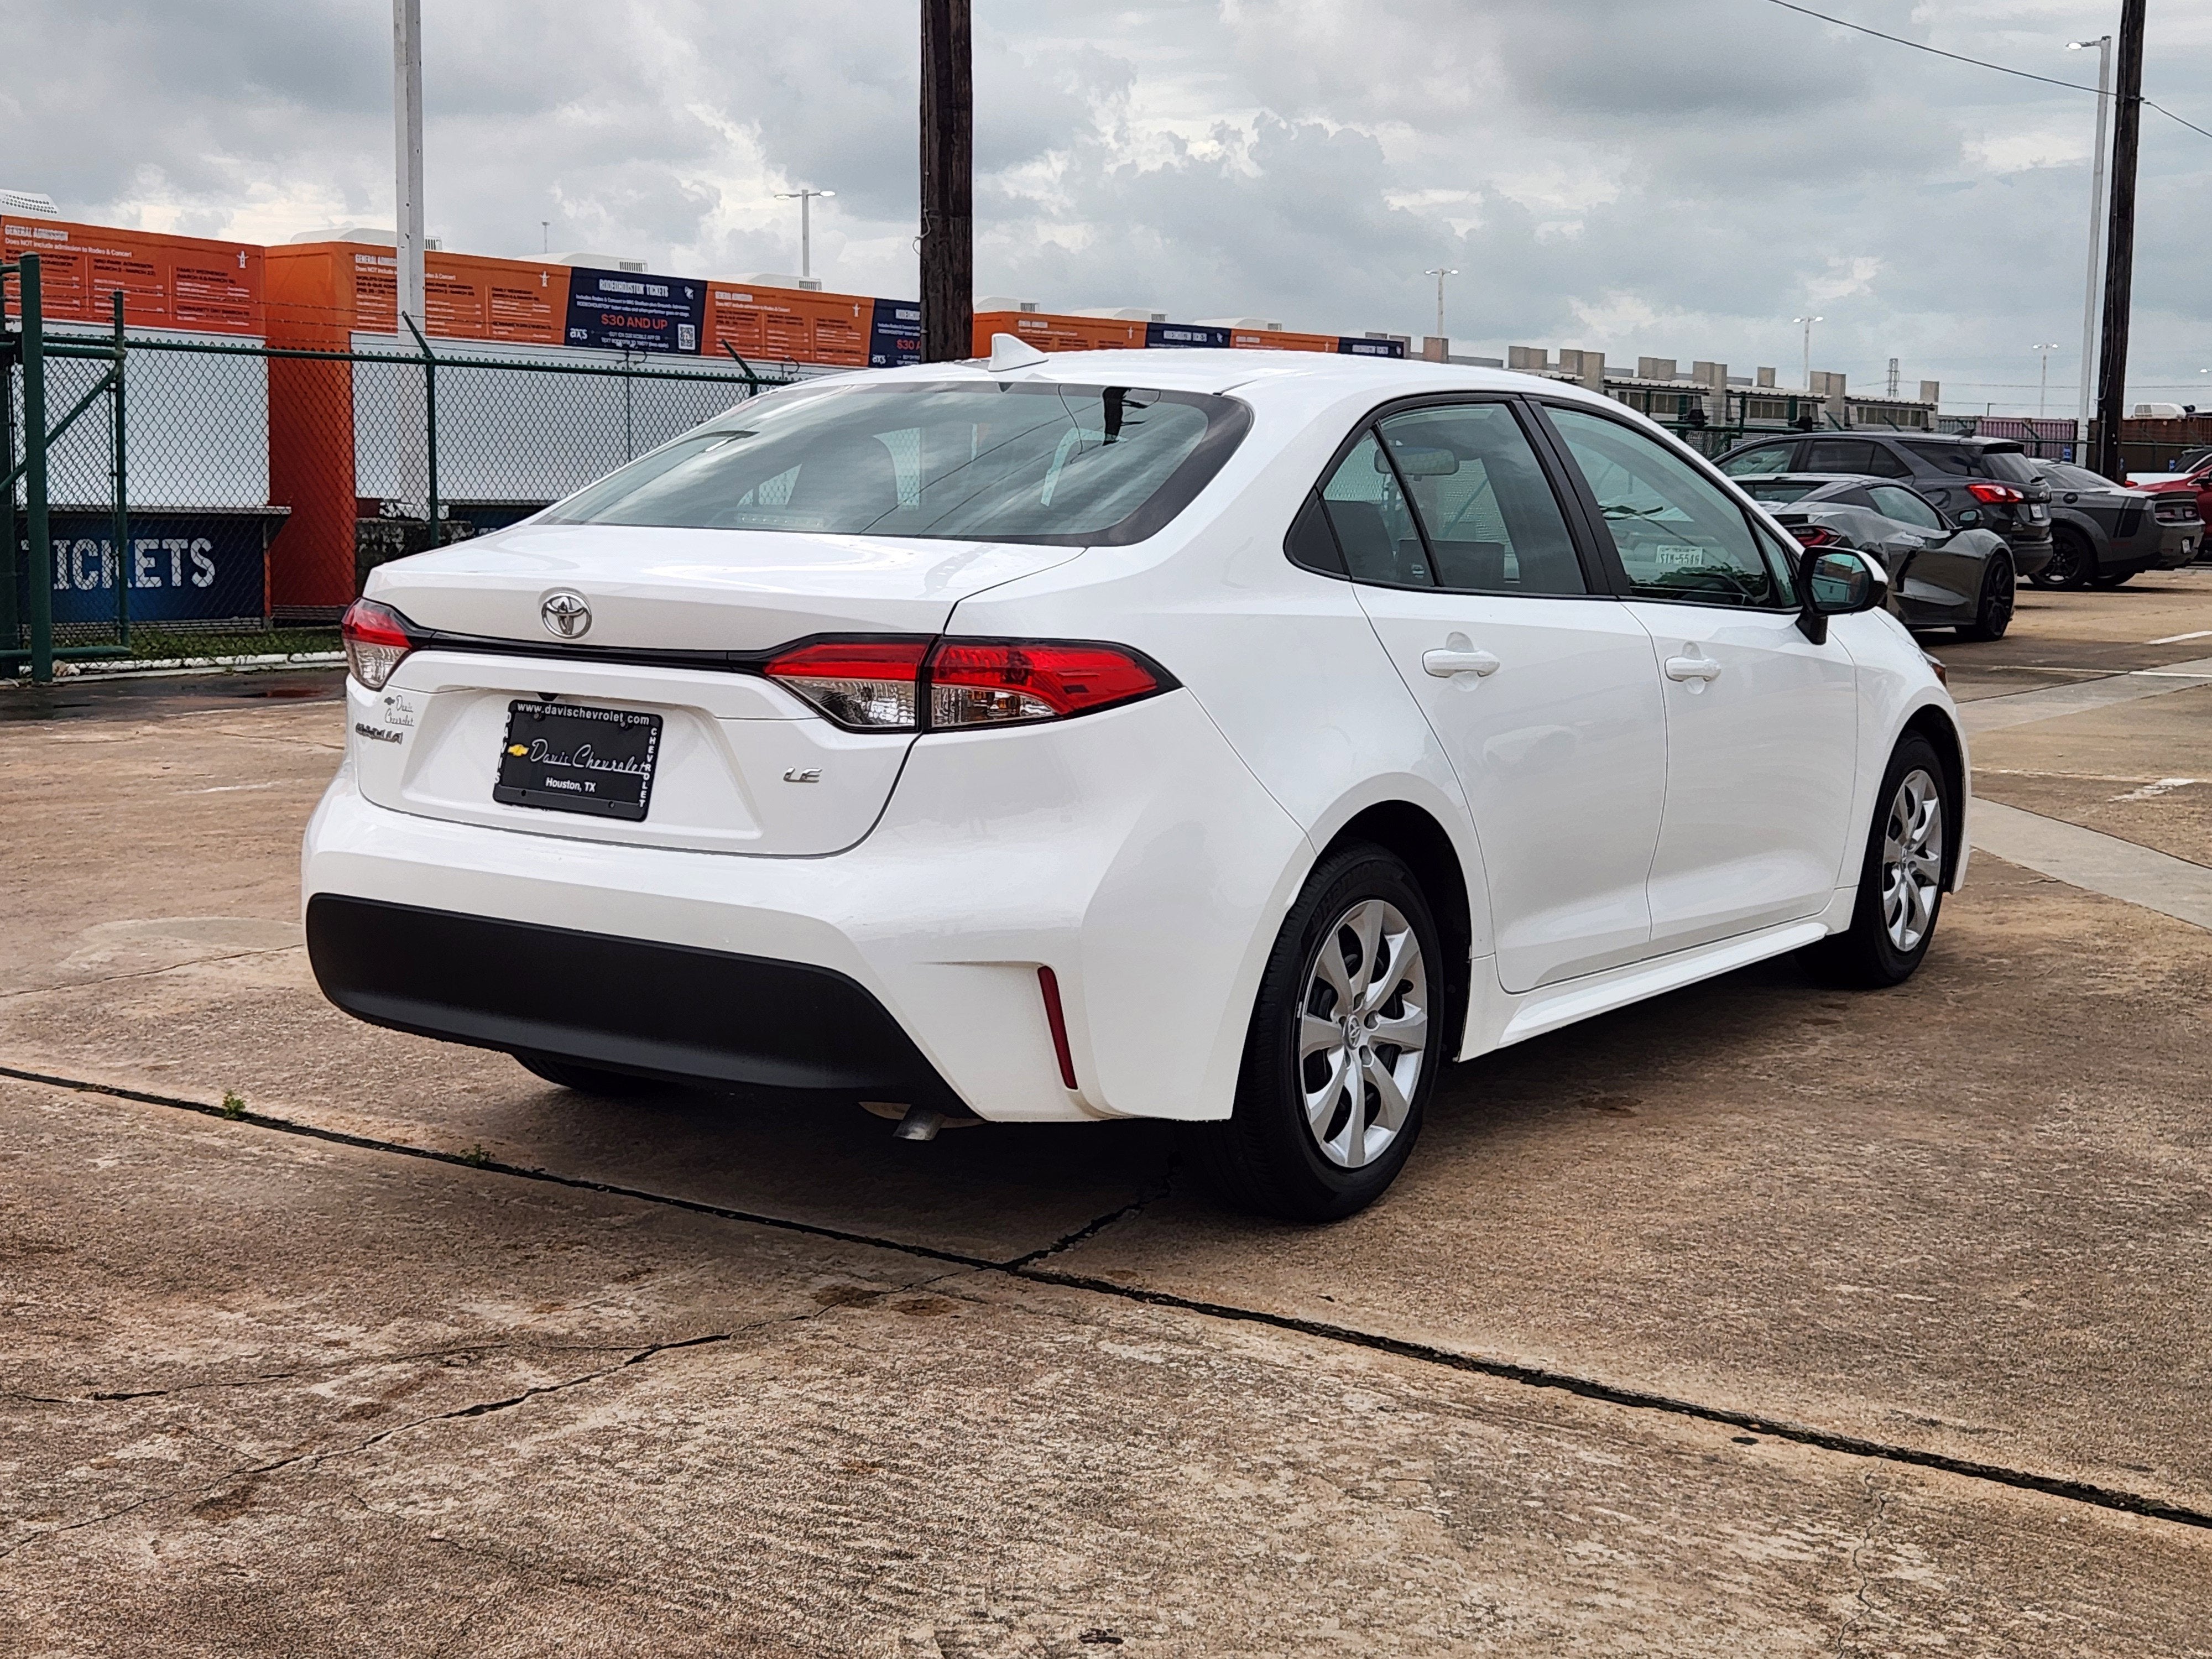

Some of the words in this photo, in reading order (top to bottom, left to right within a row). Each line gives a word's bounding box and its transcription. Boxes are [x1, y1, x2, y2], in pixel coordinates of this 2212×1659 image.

[21, 239, 33, 247] NOT
[601, 313, 625, 326] $30
[627, 316, 650, 329] AND
[653, 319, 668, 330] UP
[21, 538, 216, 590] ICKETS
[517, 703, 650, 726] www.davischevrolet.com
[495, 711, 512, 784] DAVIS
[530, 739, 571, 766] Davis
[572, 744, 646, 775] Chevrolet
[639, 727, 658, 808] CHEVROLET
[783, 767, 822, 782] LE
[546, 776, 582, 792] Houston,
[585, 781, 597, 792] TX
